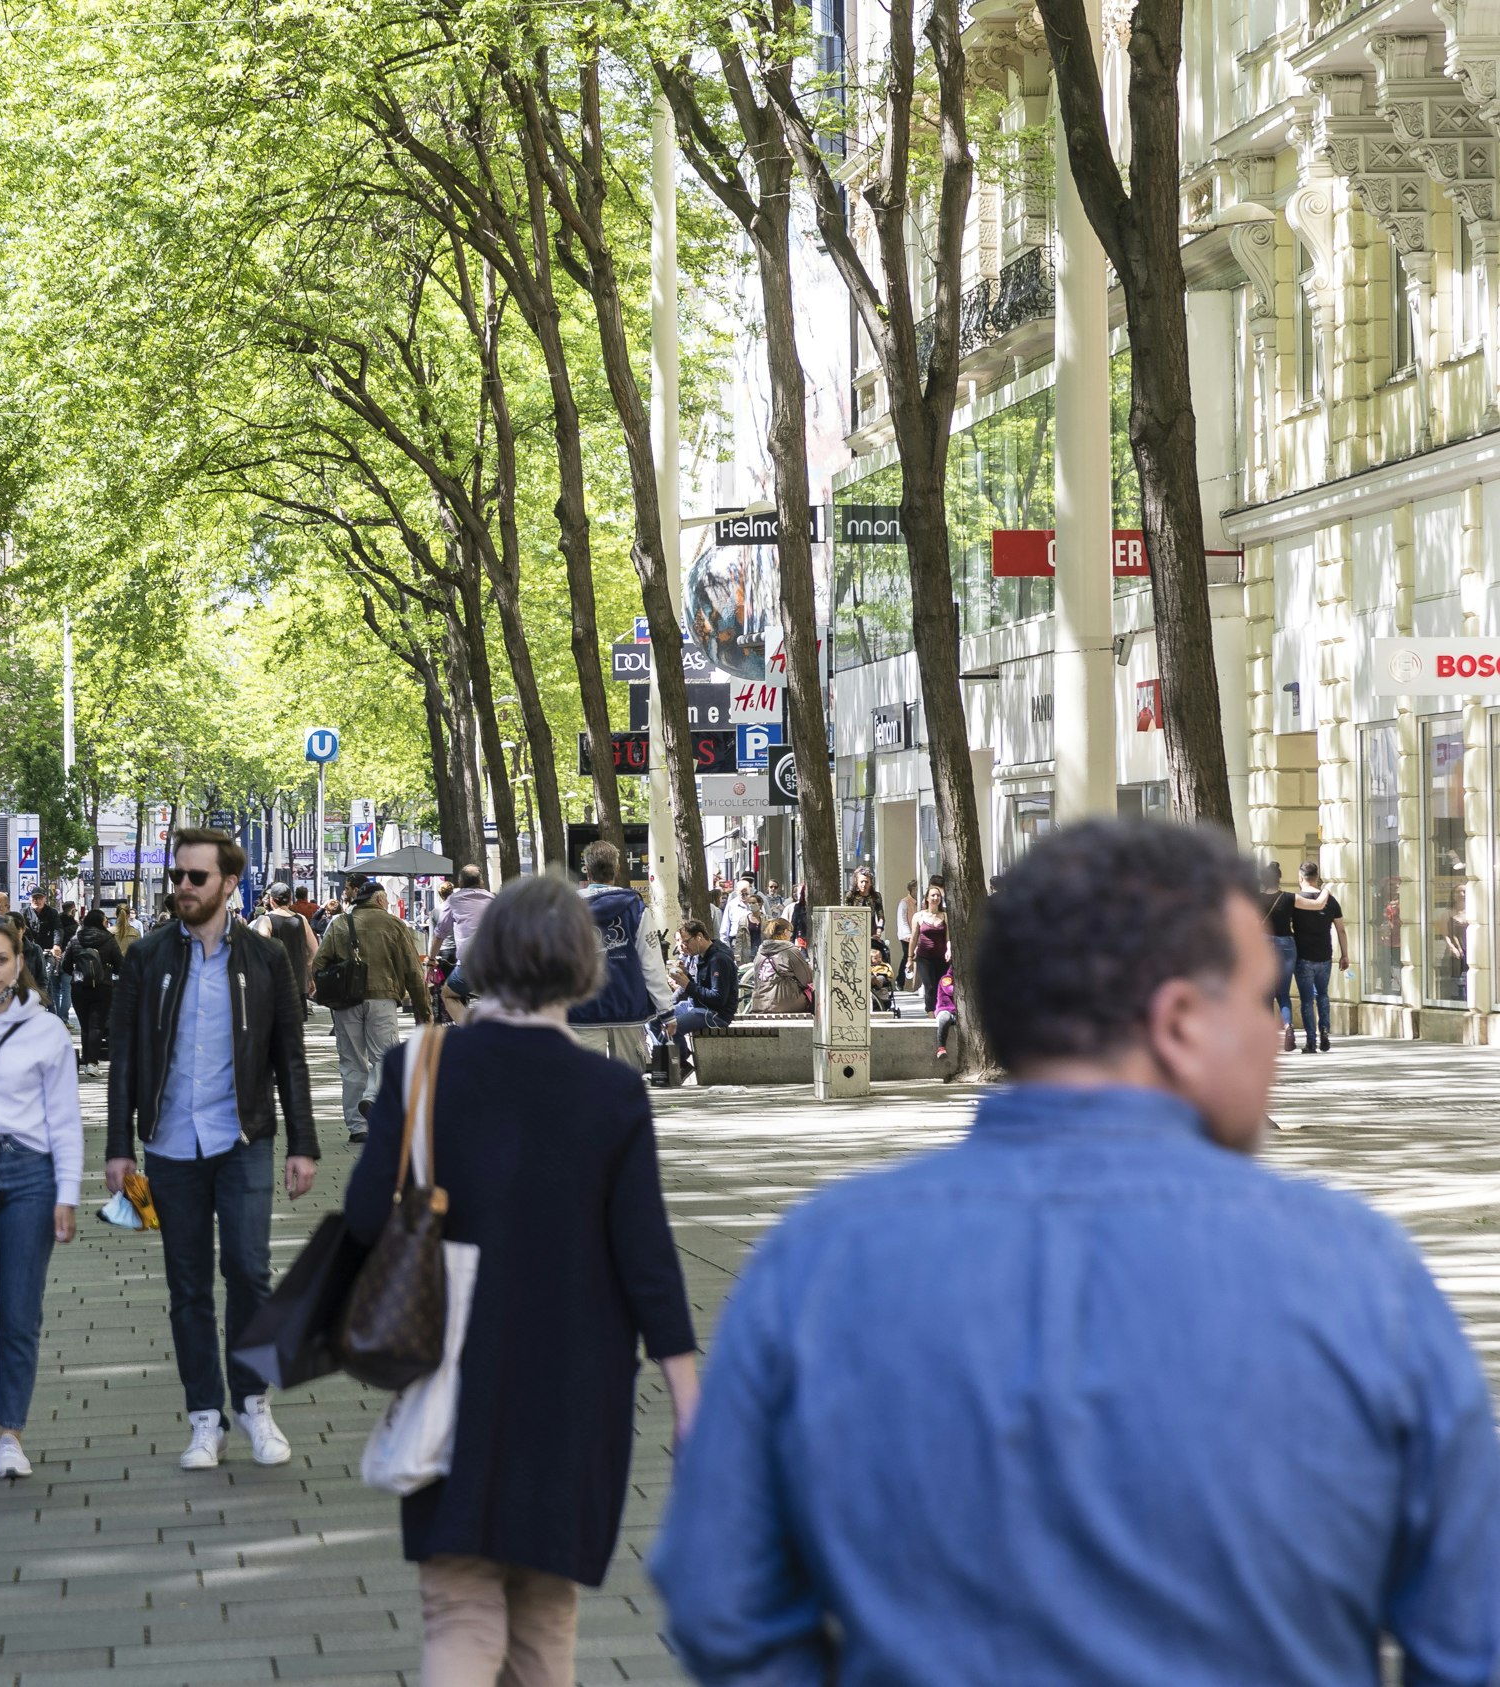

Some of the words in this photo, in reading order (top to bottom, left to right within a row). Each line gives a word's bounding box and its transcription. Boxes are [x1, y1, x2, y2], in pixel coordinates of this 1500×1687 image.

[1436, 654, 1500, 678] BOS
[734, 684, 777, 712] H&M
[311, 735, 333, 757] U
[746, 732, 769, 760] P
